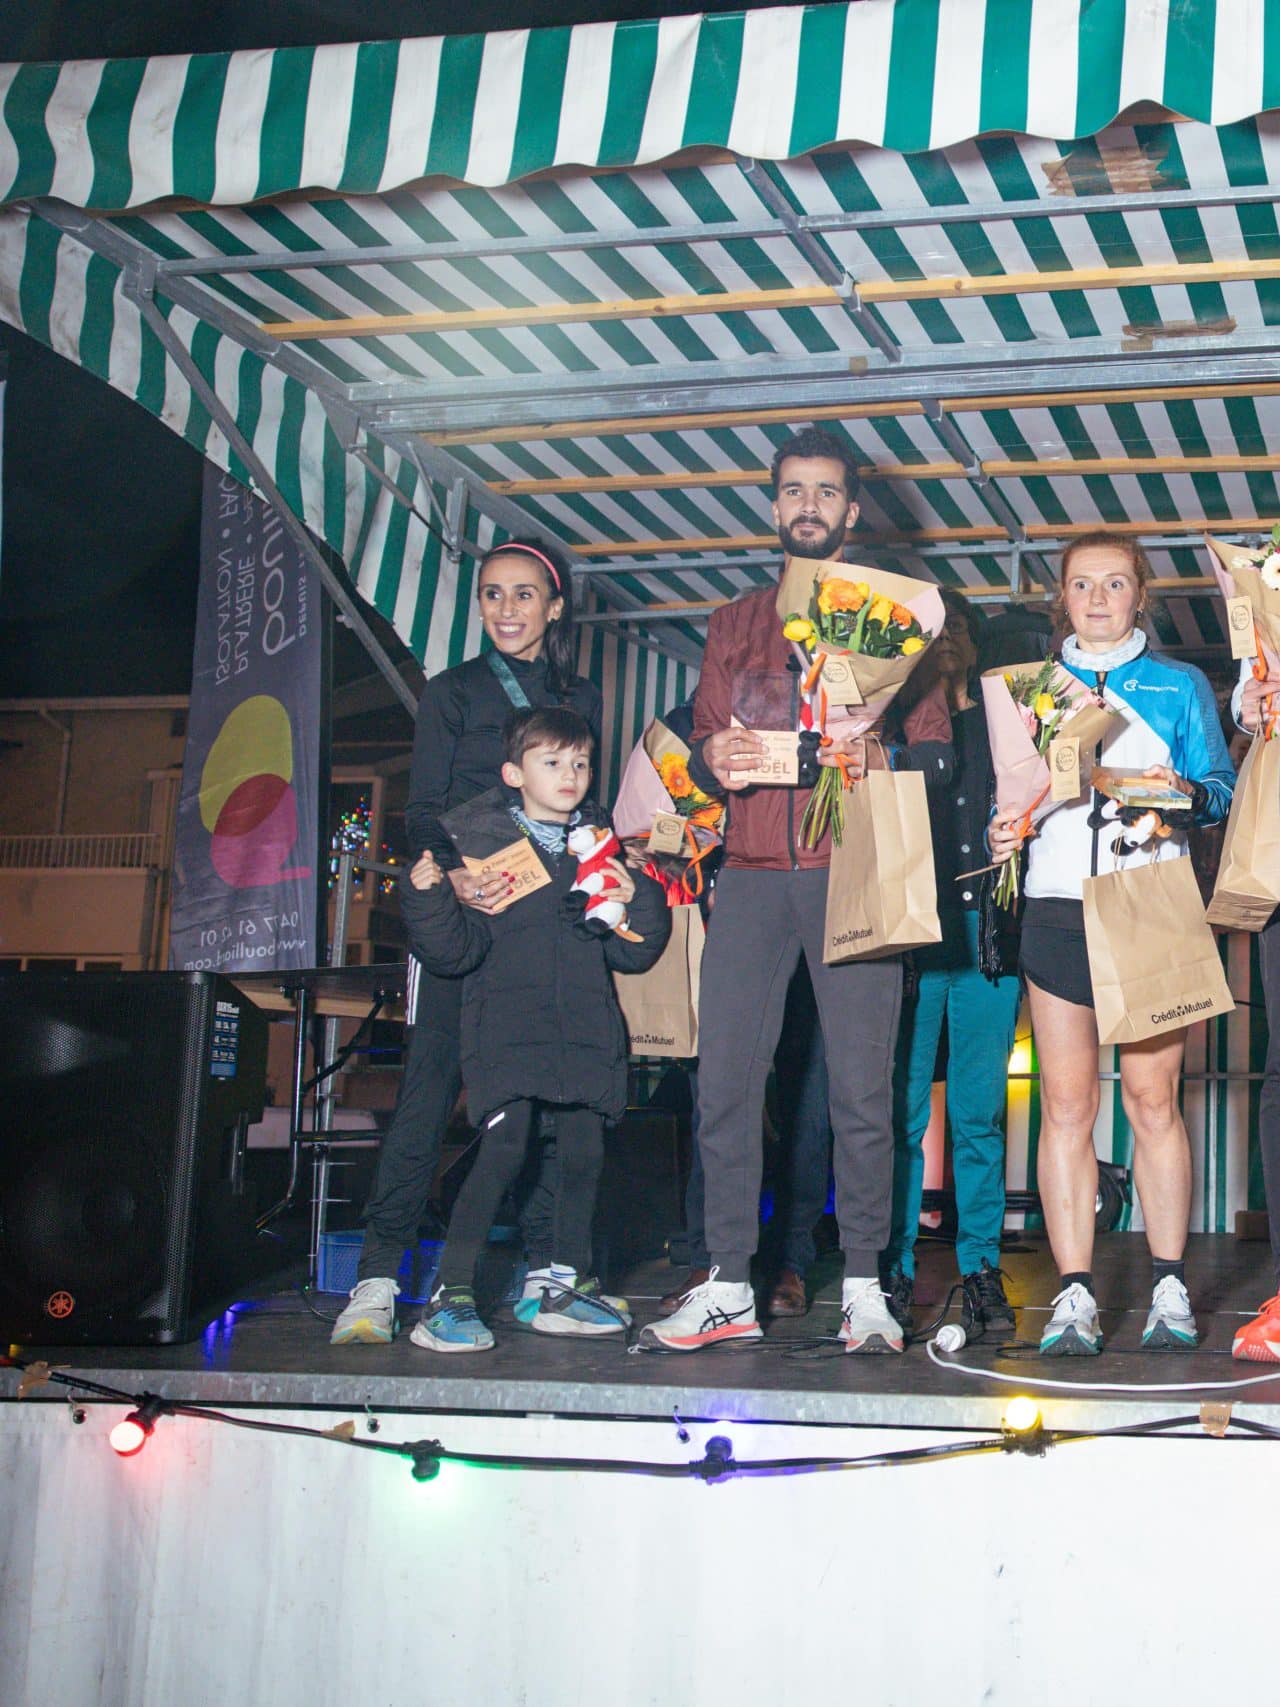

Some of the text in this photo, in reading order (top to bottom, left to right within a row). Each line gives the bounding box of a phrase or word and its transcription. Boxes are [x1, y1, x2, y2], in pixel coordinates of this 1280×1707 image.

[852, 926, 873, 939] Mutuel
[1151, 998, 1214, 1025] Crédit Mutuel
